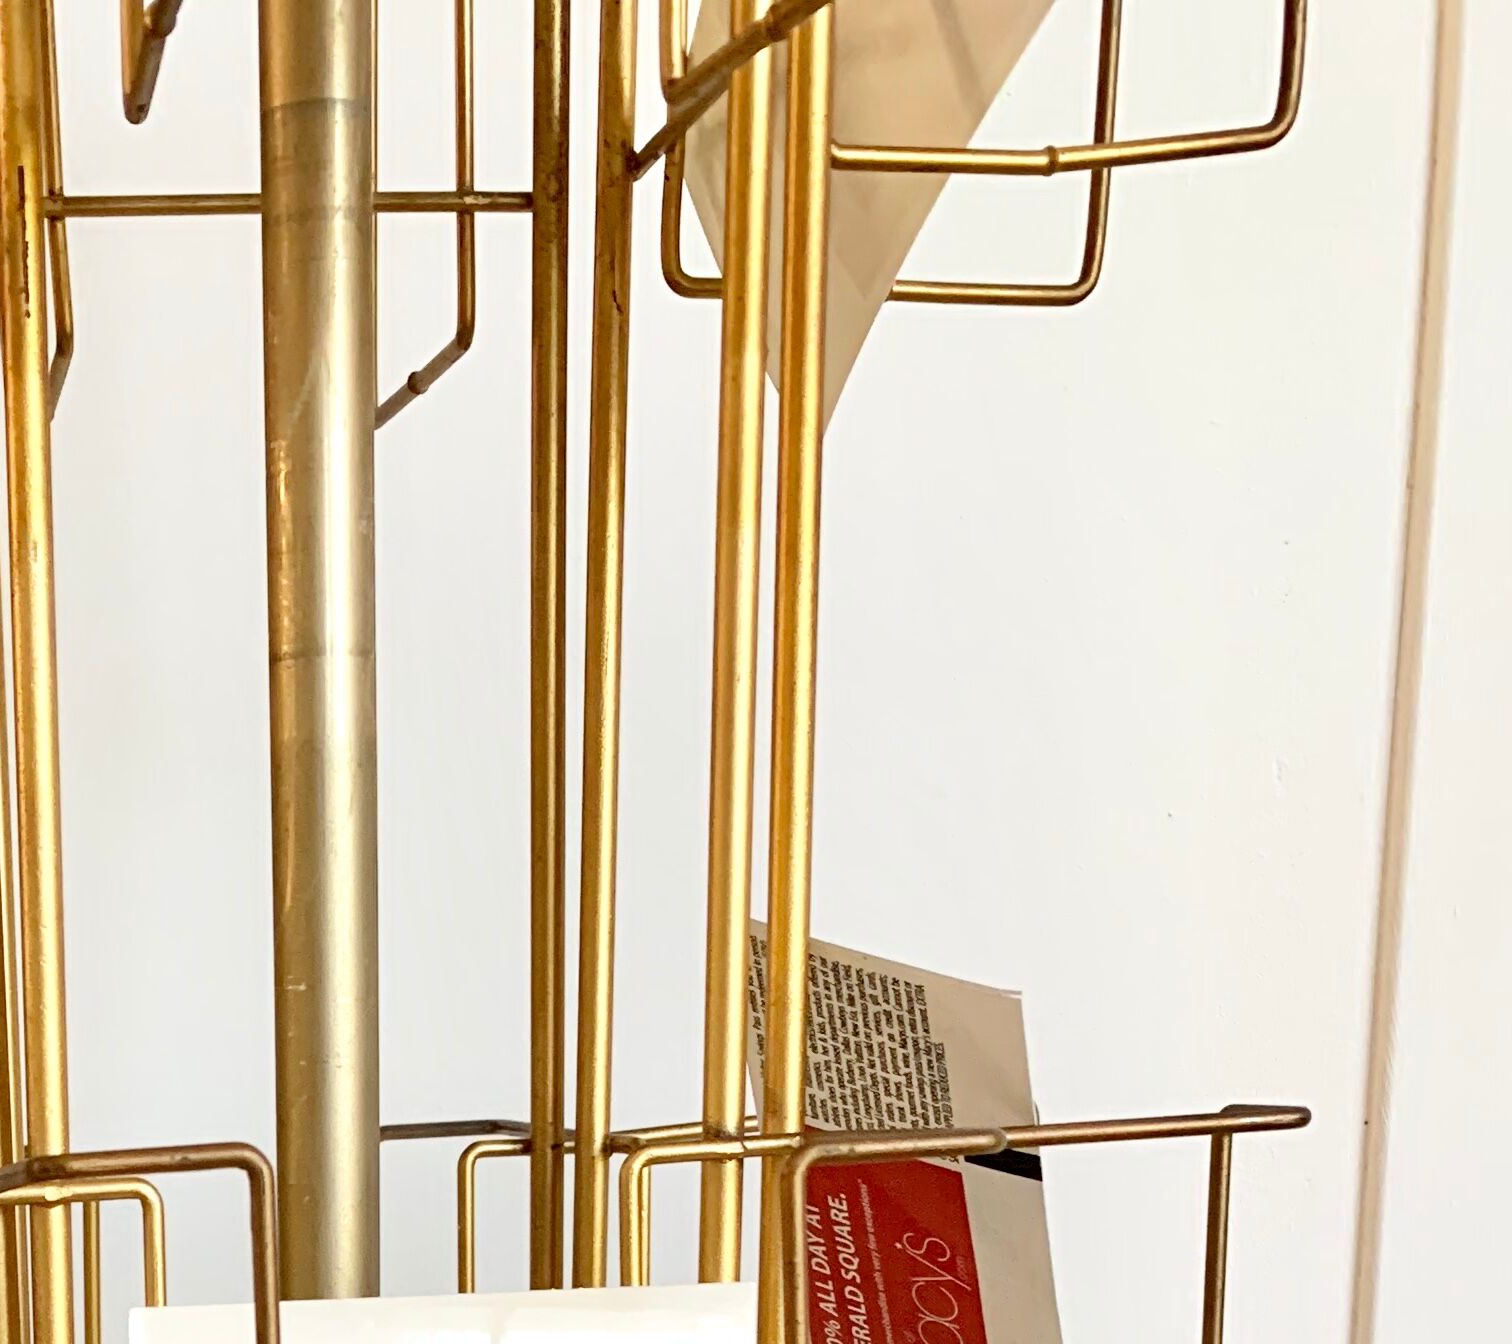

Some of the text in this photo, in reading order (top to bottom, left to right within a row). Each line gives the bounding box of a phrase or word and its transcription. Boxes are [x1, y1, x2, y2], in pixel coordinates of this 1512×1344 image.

[806, 1229, 831, 1275] DAY
[827, 1193, 861, 1283] SQUARE.
[814, 1277, 838, 1317] ALL
